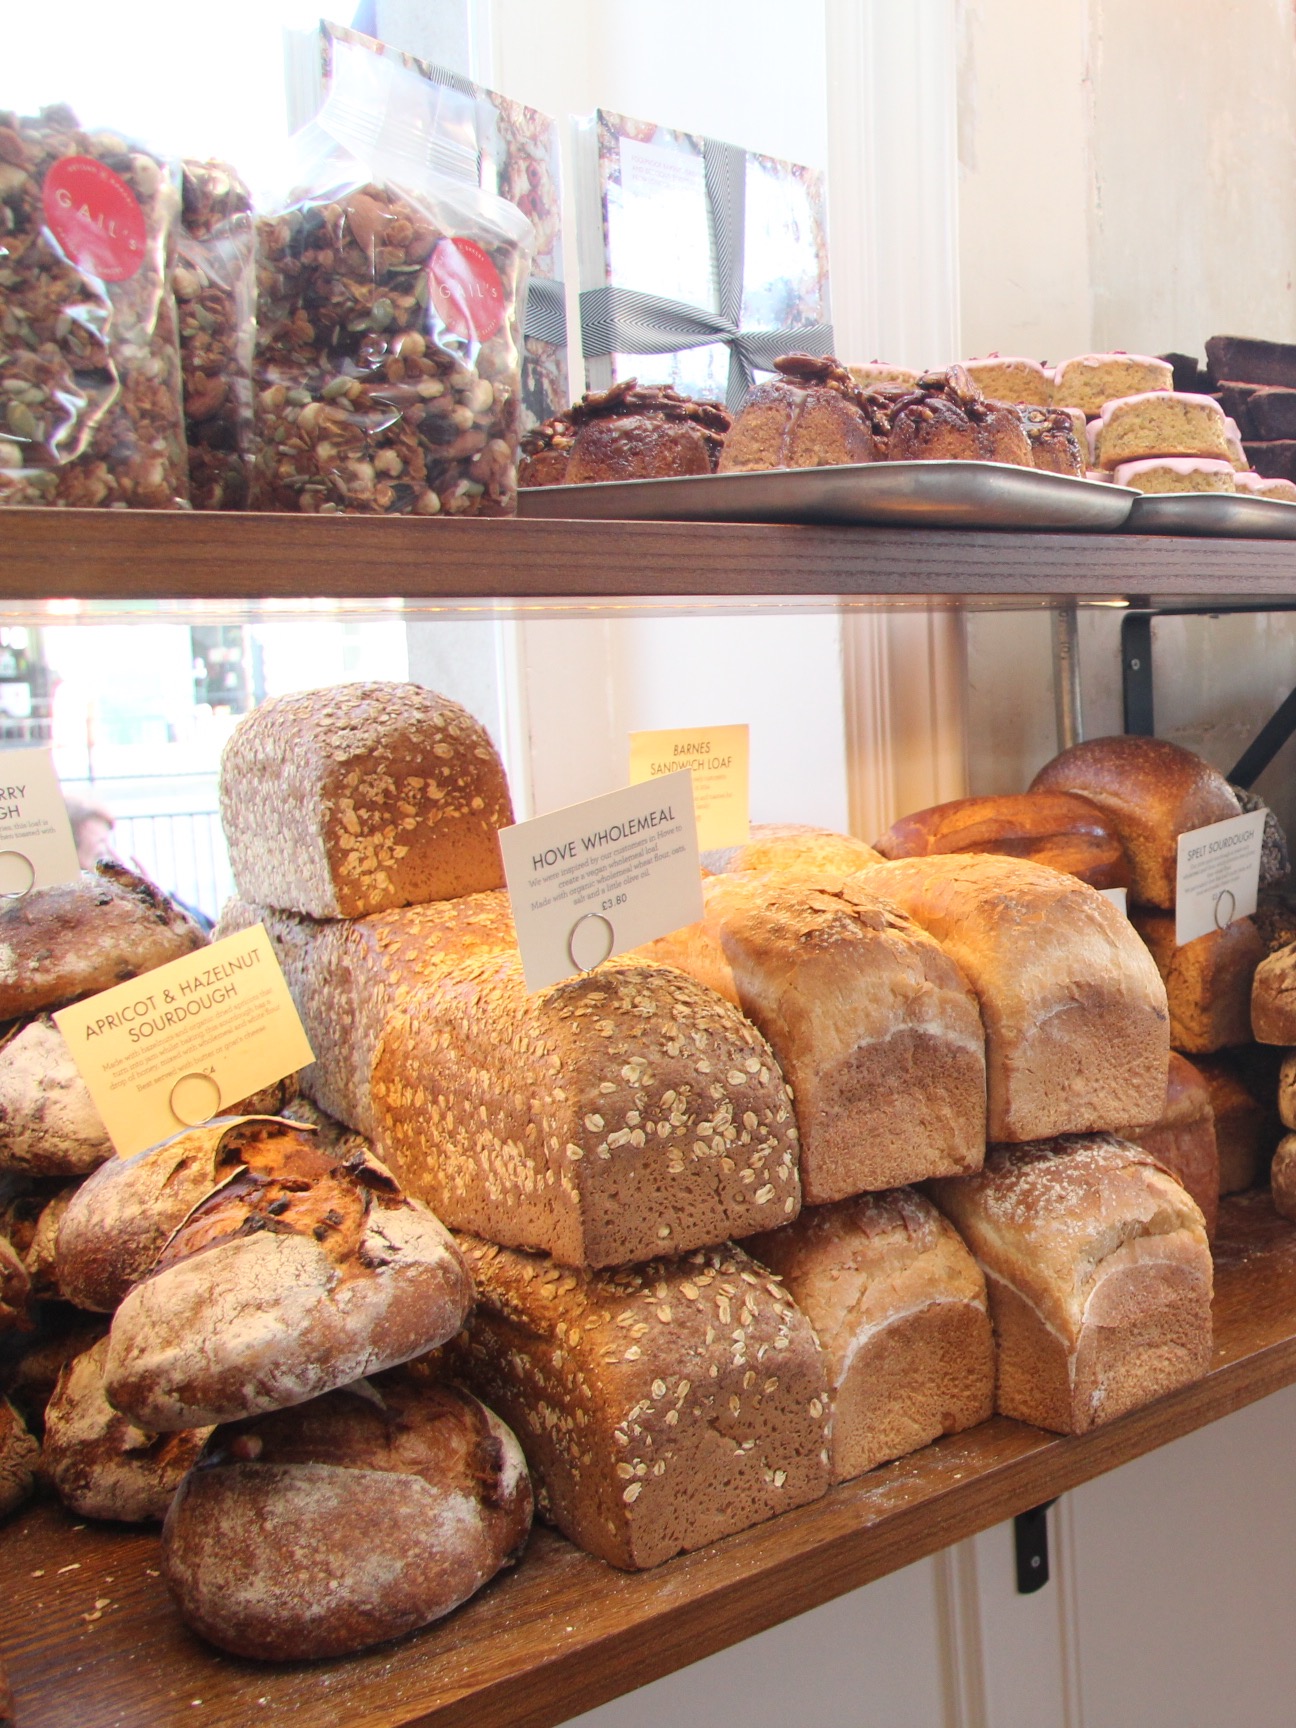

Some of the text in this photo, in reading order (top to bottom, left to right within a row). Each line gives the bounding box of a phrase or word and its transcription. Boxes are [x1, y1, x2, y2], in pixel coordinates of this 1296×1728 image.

[650, 756, 733, 775] SANDWICH LOAF
[673, 741, 711, 756] BARNES
[529, 878, 541, 888] We
[542, 872, 559, 882] were
[561, 858, 589, 876] inspired
[589, 857, 599, 865] by
[600, 852, 612, 861] our
[613, 839, 648, 855] customers
[657, 828, 674, 839] Hove
[533, 807, 674, 870] HOVE WHOLEMEAL
[1188, 830, 1254, 861] SPELT SOURDOUGH
[531, 897, 551, 911] Made
[552, 890, 568, 902] with
[569, 881, 595, 896] organic
[596, 864, 632, 884] wholemeal
[633, 858, 653, 870] wheat
[558, 876, 579, 888] create
[586, 865, 607, 877] vegan
[608, 848, 644, 868] wholemeal
[573, 895, 585, 905] salt
[587, 888, 600, 899] and
[606, 880, 622, 891] little
[623, 874, 639, 885] olive
[602, 893, 627, 911] £3.80
[86, 949, 259, 1040] APRICOT & HAZELNUT
[129, 983, 237, 1042] SOURDOUGH
